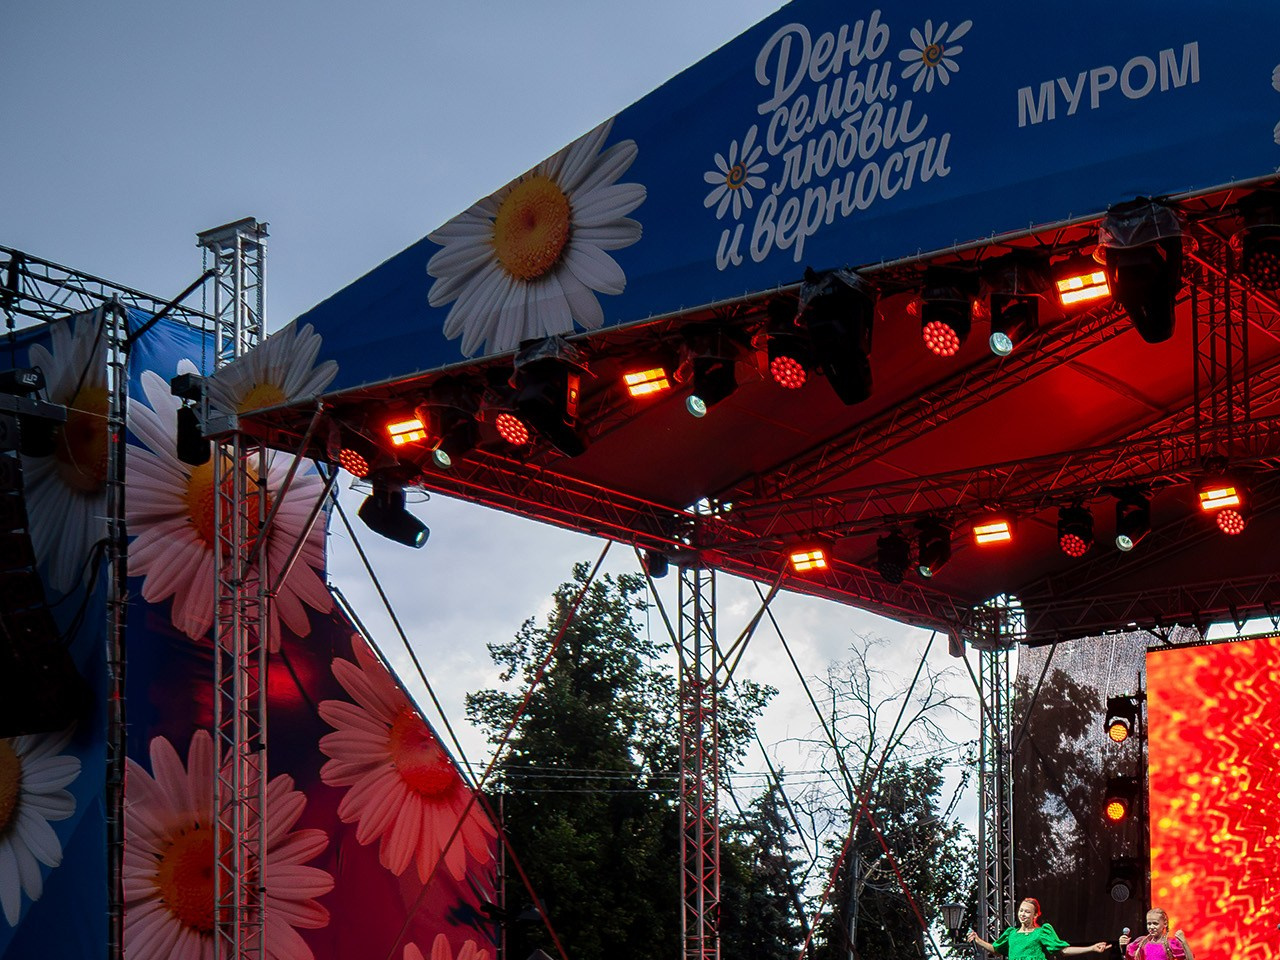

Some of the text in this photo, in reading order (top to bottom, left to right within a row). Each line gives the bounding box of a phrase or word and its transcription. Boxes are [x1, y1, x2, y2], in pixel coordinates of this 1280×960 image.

[755, 9, 890, 115] День
[766, 61, 898, 156] семьи,
[1017, 41, 1200, 128] МУРОМ
[771, 100, 928, 198] любви
[716, 132, 951, 271] и верности
